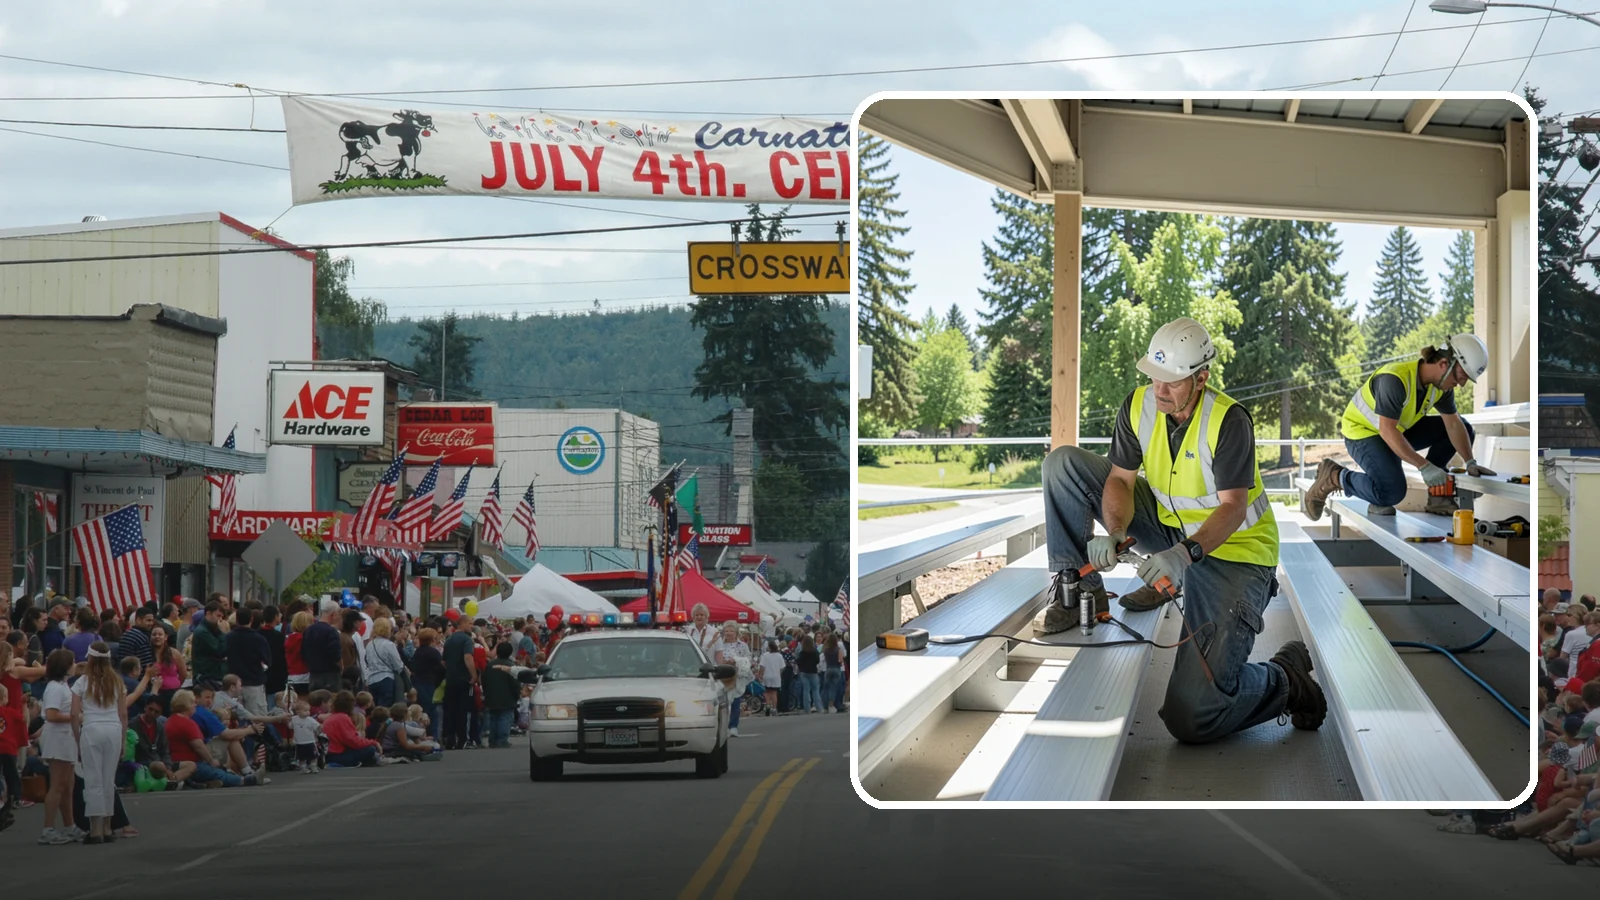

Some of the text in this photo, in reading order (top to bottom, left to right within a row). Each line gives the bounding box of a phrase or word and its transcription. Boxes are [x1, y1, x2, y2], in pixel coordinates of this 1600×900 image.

[481, 140, 604, 192] JULY
[632, 150, 746, 198] 4th.
[697, 254, 850, 280] CROSSWA
[282, 380, 373, 420] ACE
[405, 409, 453, 422] CEDAR
[283, 421, 371, 436] Hardware
[416, 428, 476, 446] Coca-Cola
[353, 466, 385, 480] Simpl
[83, 485, 155, 495] St. Vincent de Paul
[81, 503, 154, 522] THT
[212, 516, 331, 536] HARDARE
[688, 526, 741, 535] CRNATION
[699, 535, 730, 543] GLASS
